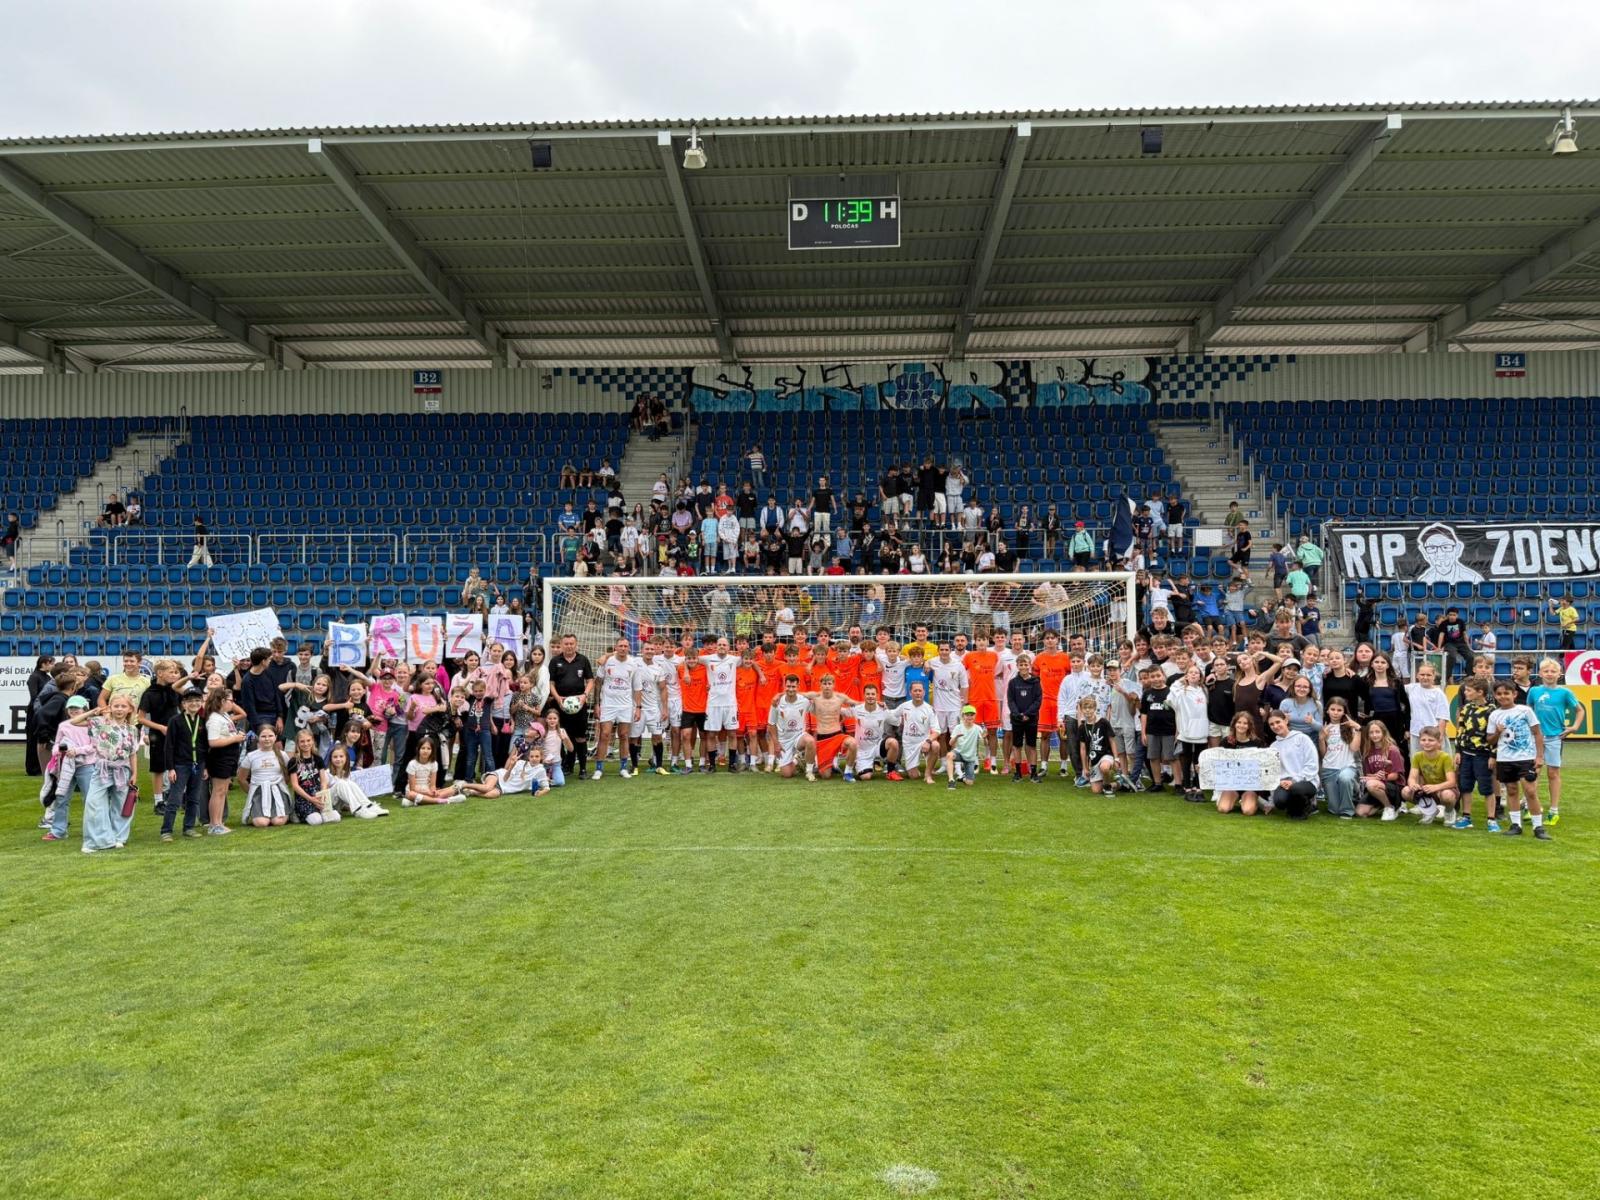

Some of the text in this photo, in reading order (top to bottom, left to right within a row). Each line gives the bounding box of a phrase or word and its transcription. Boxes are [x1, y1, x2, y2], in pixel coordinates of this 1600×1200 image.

[792, 200, 897, 223] D 11:39 H
[1500, 355, 1520, 367] B4
[419, 372, 437, 383] B2
[1341, 533, 1406, 578] RIP
[0, 705, 28, 734] E
